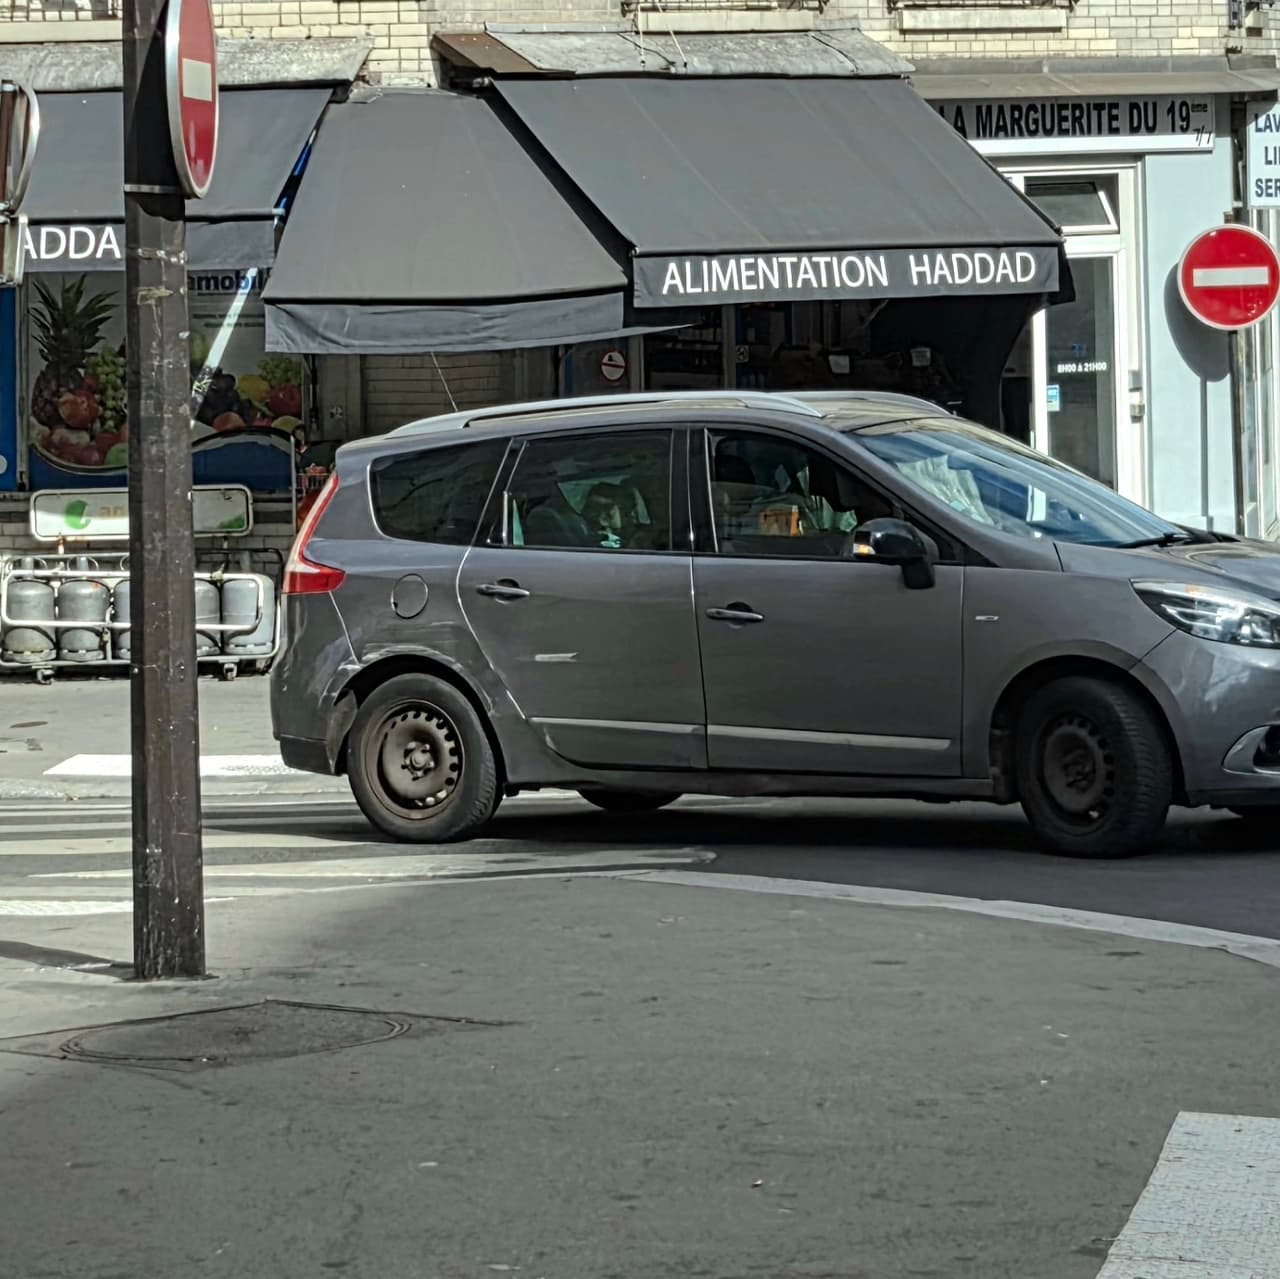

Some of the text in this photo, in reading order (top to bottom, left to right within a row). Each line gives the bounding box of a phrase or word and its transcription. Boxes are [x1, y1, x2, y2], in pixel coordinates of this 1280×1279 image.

[976, 101, 1120, 138] MARGUERITE
[1129, 101, 1157, 134] DU
[662, 251, 1036, 294] ALIMENTATION HADDAD
[1083, 362, 1107, 372] 21H00
